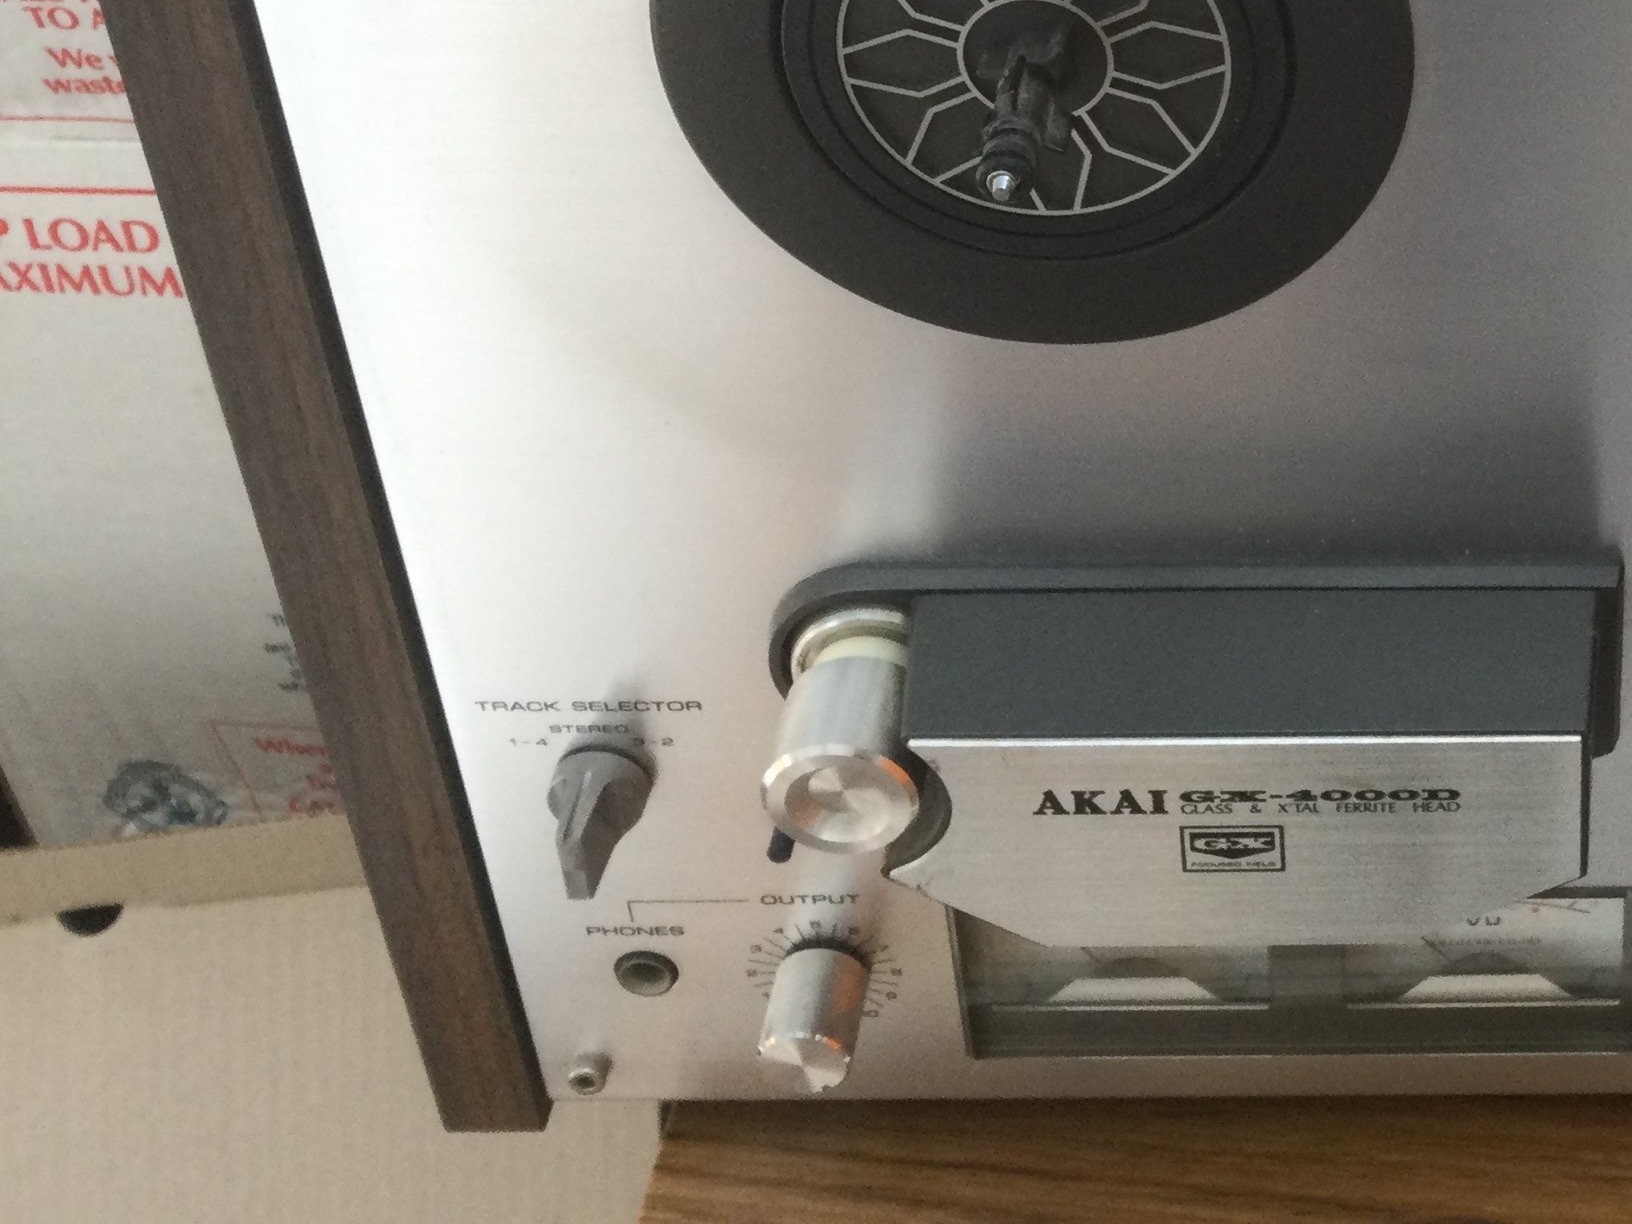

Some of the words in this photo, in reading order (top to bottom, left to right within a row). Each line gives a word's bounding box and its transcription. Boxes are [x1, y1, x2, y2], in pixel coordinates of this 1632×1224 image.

[22, 6, 79, 30] TO
[45, 46, 105, 70] We
[22, 217, 160, 253] LOAD
[474, 700, 559, 712] TRACK
[571, 700, 702, 712] SELECTOR
[548, 724, 629, 734] STEREO
[1032, 789, 1168, 816] AKAI
[1179, 789, 1461, 802] GX-4000D
[1180, 803, 1233, 814] GLASS
[1250, 803, 1261, 814] &
[1335, 802, 1397, 813] FERRITE
[1412, 802, 1461, 813] HEAD
[760, 894, 860, 905] OUTPUT
[585, 926, 685, 937] PHONES
